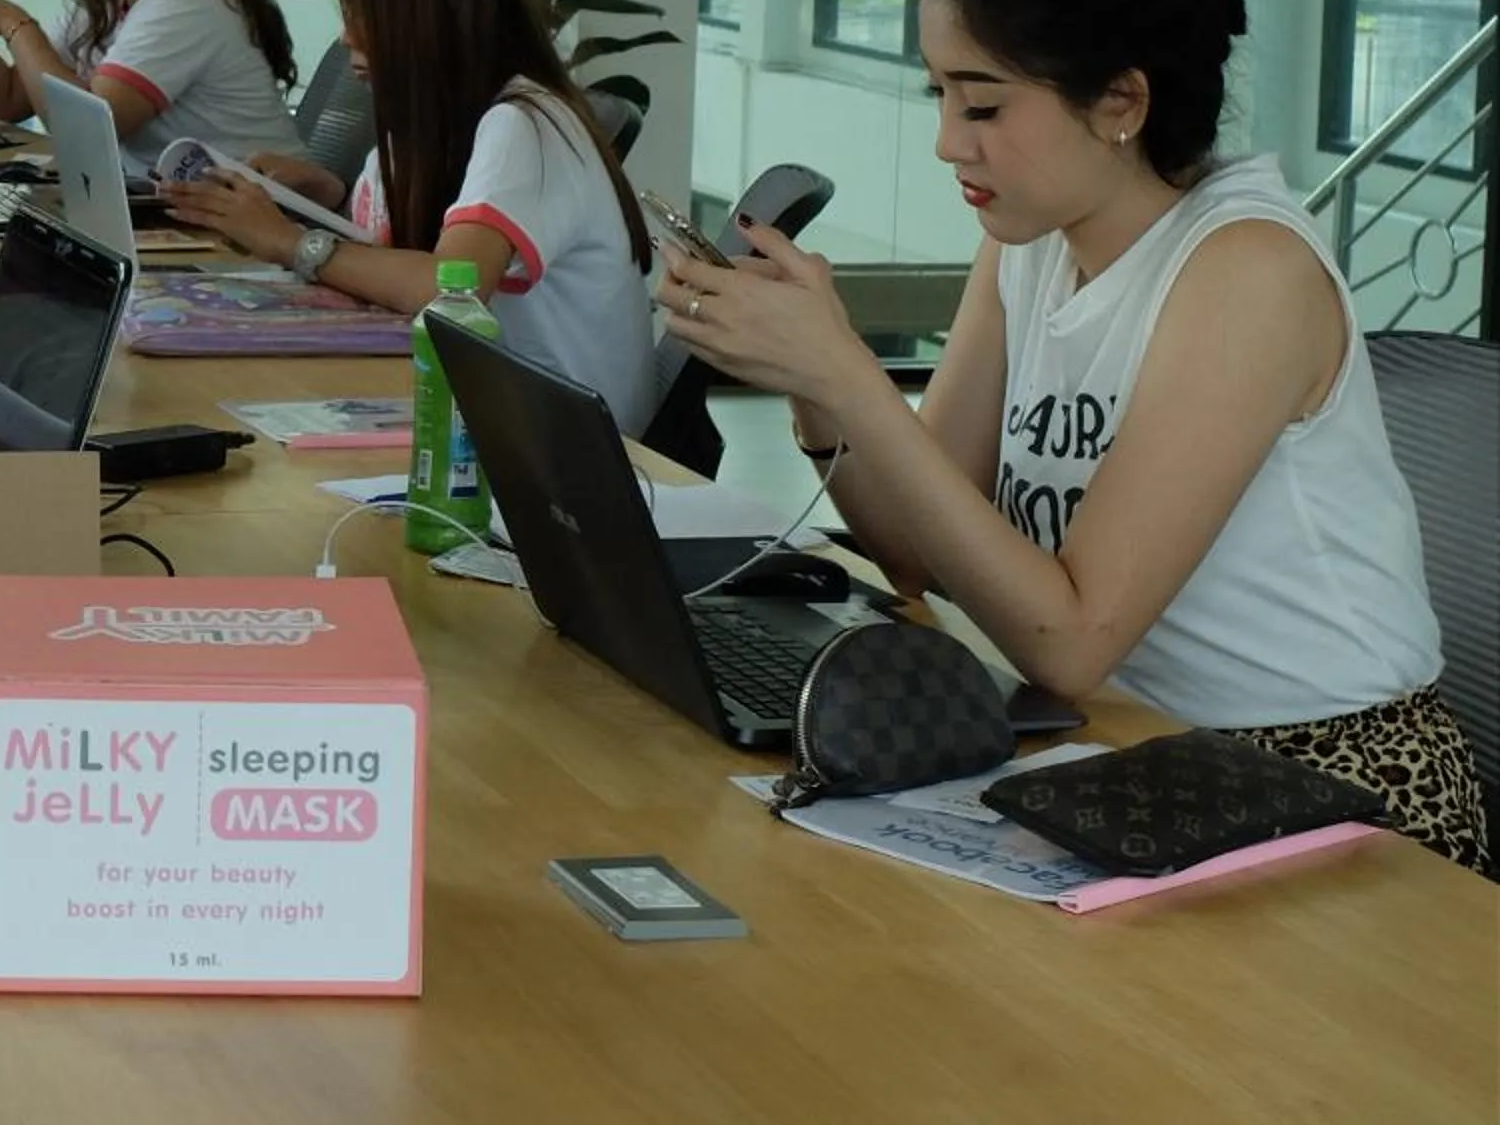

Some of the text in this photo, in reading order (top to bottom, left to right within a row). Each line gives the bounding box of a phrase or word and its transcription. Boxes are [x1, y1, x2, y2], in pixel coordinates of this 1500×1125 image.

[4, 727, 178, 772] MiLKY
[208, 740, 381, 784] sleeping
[12, 777, 165, 837] jeLLy
[225, 794, 365, 833] MASK
[97, 862, 297, 889] for your beauty
[67, 898, 325, 925] boost in every night
[169, 951, 223, 967] 15 ml.
